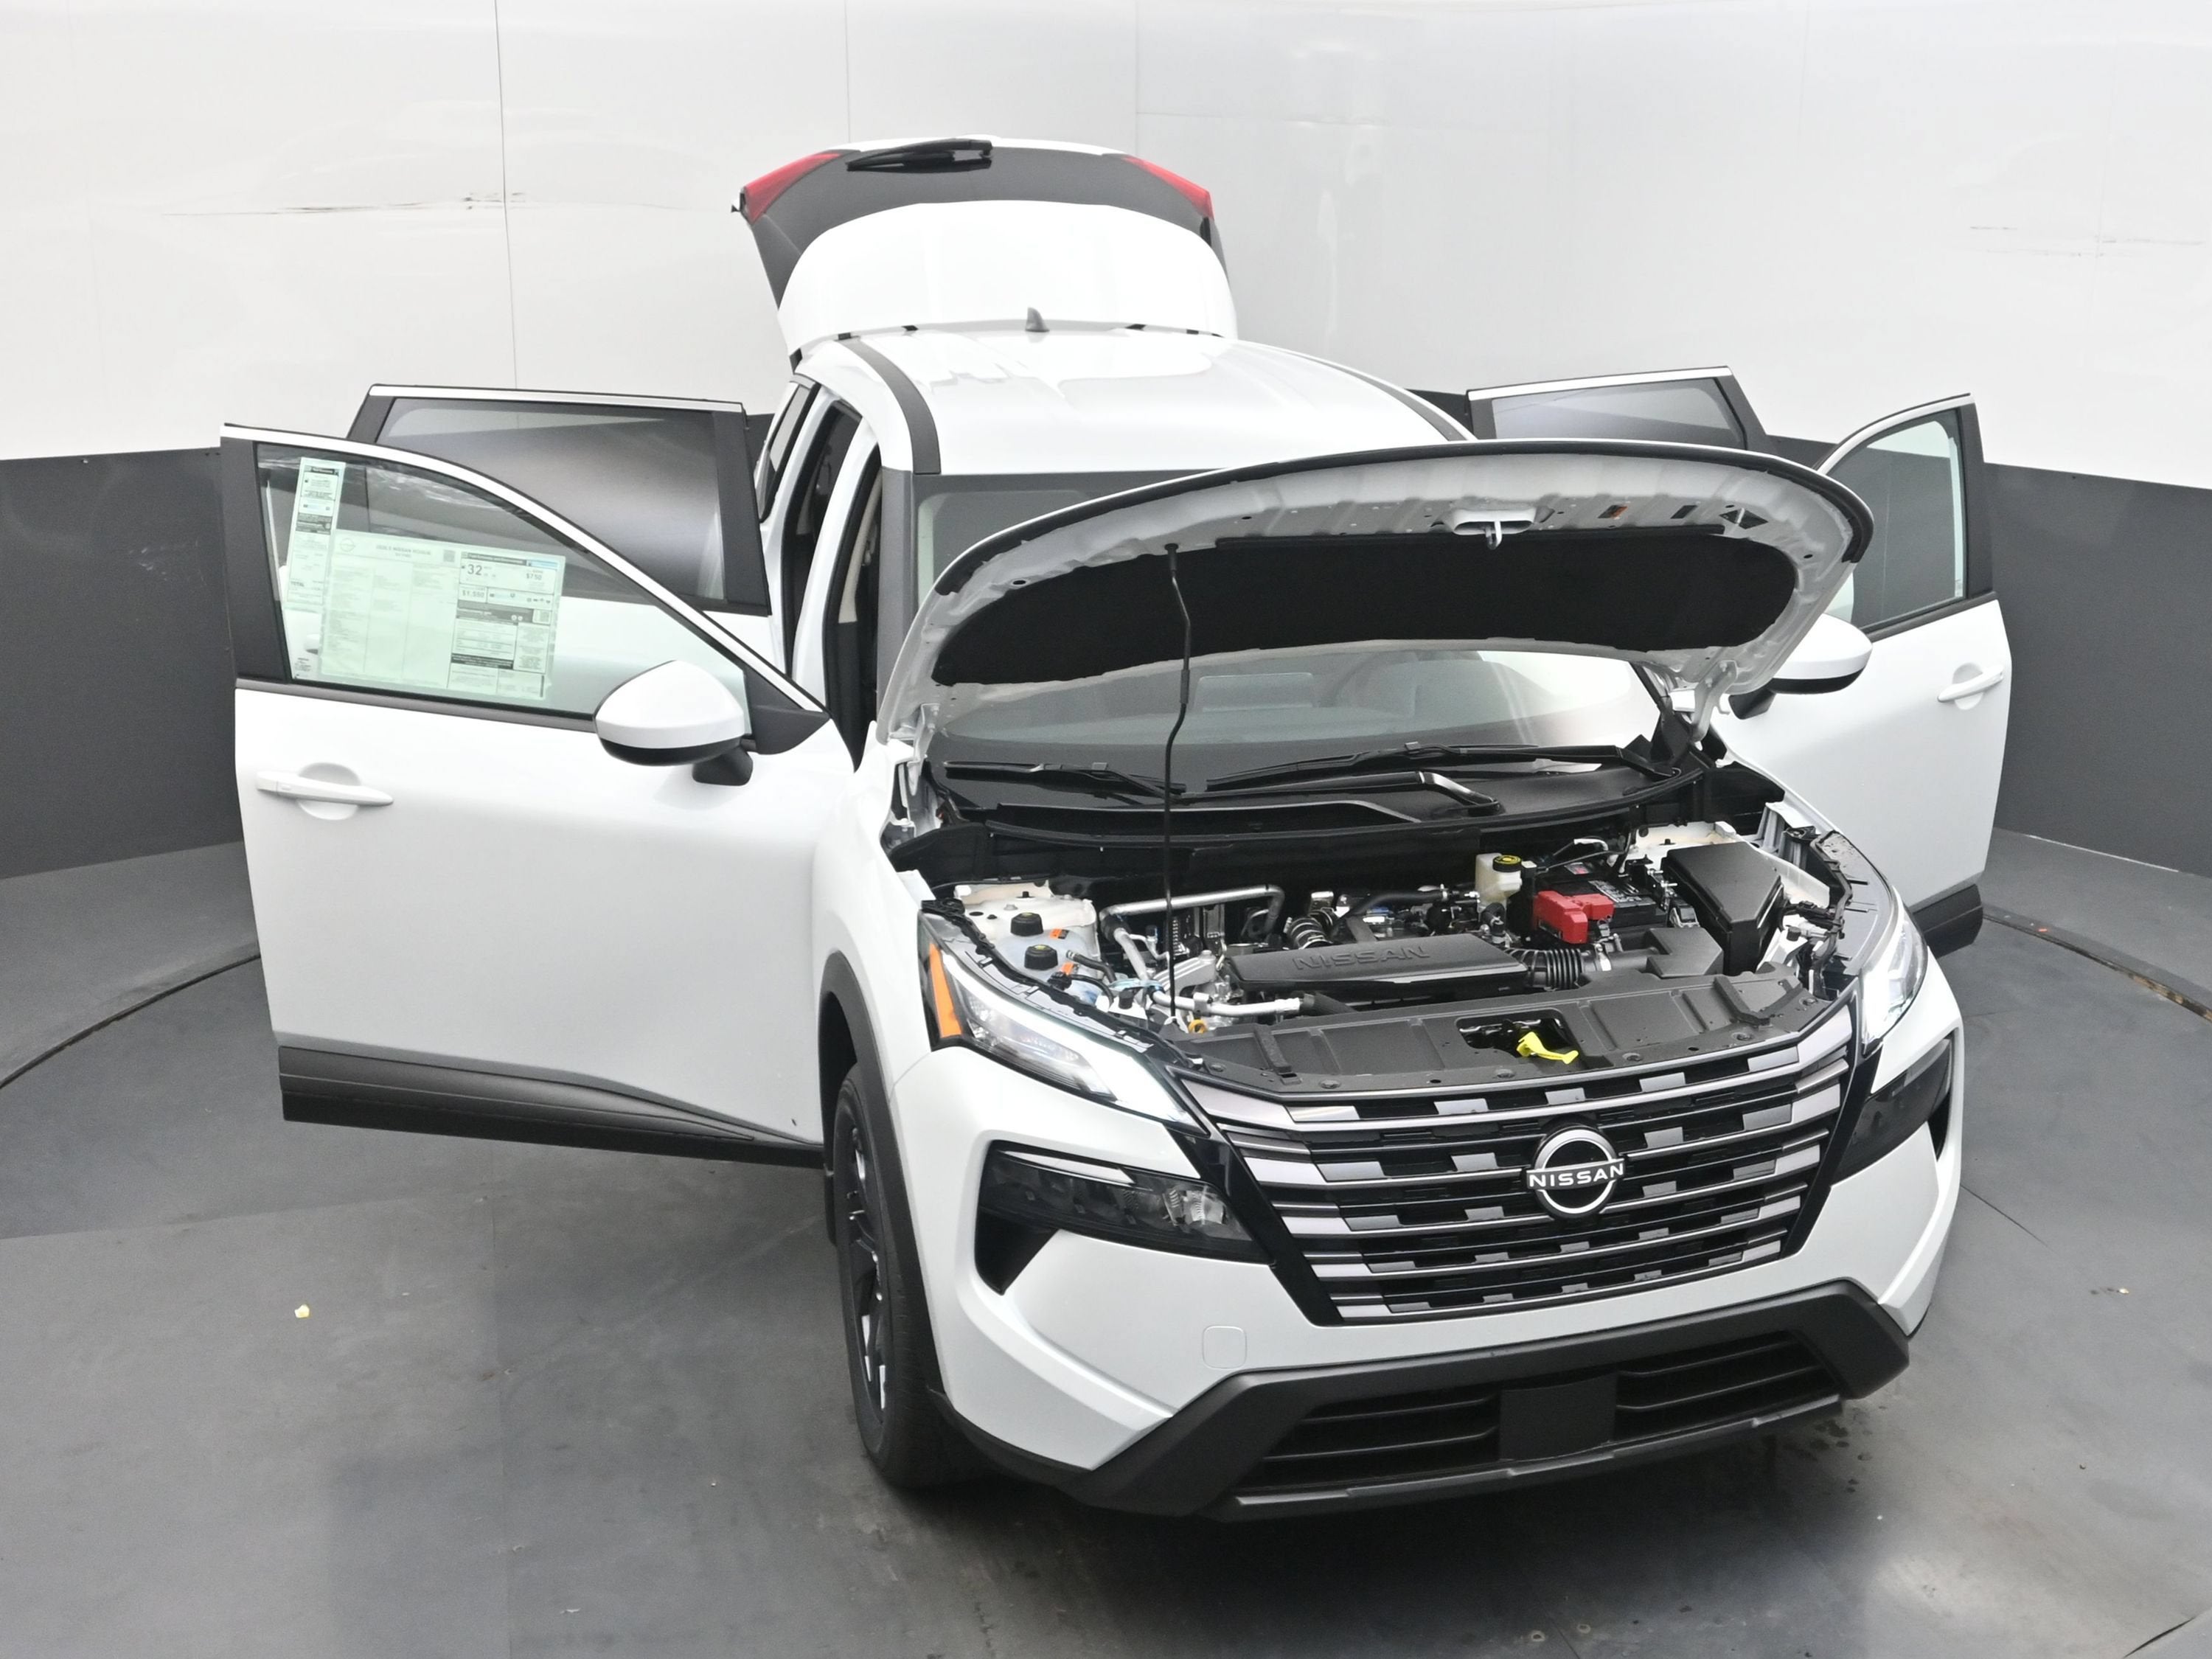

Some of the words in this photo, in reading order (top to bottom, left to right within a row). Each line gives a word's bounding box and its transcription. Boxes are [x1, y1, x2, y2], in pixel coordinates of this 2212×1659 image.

[467, 563, 482, 576] 32
[1292, 946, 1430, 970] NISSAN
[1528, 1163, 1624, 1187] NISSAN
